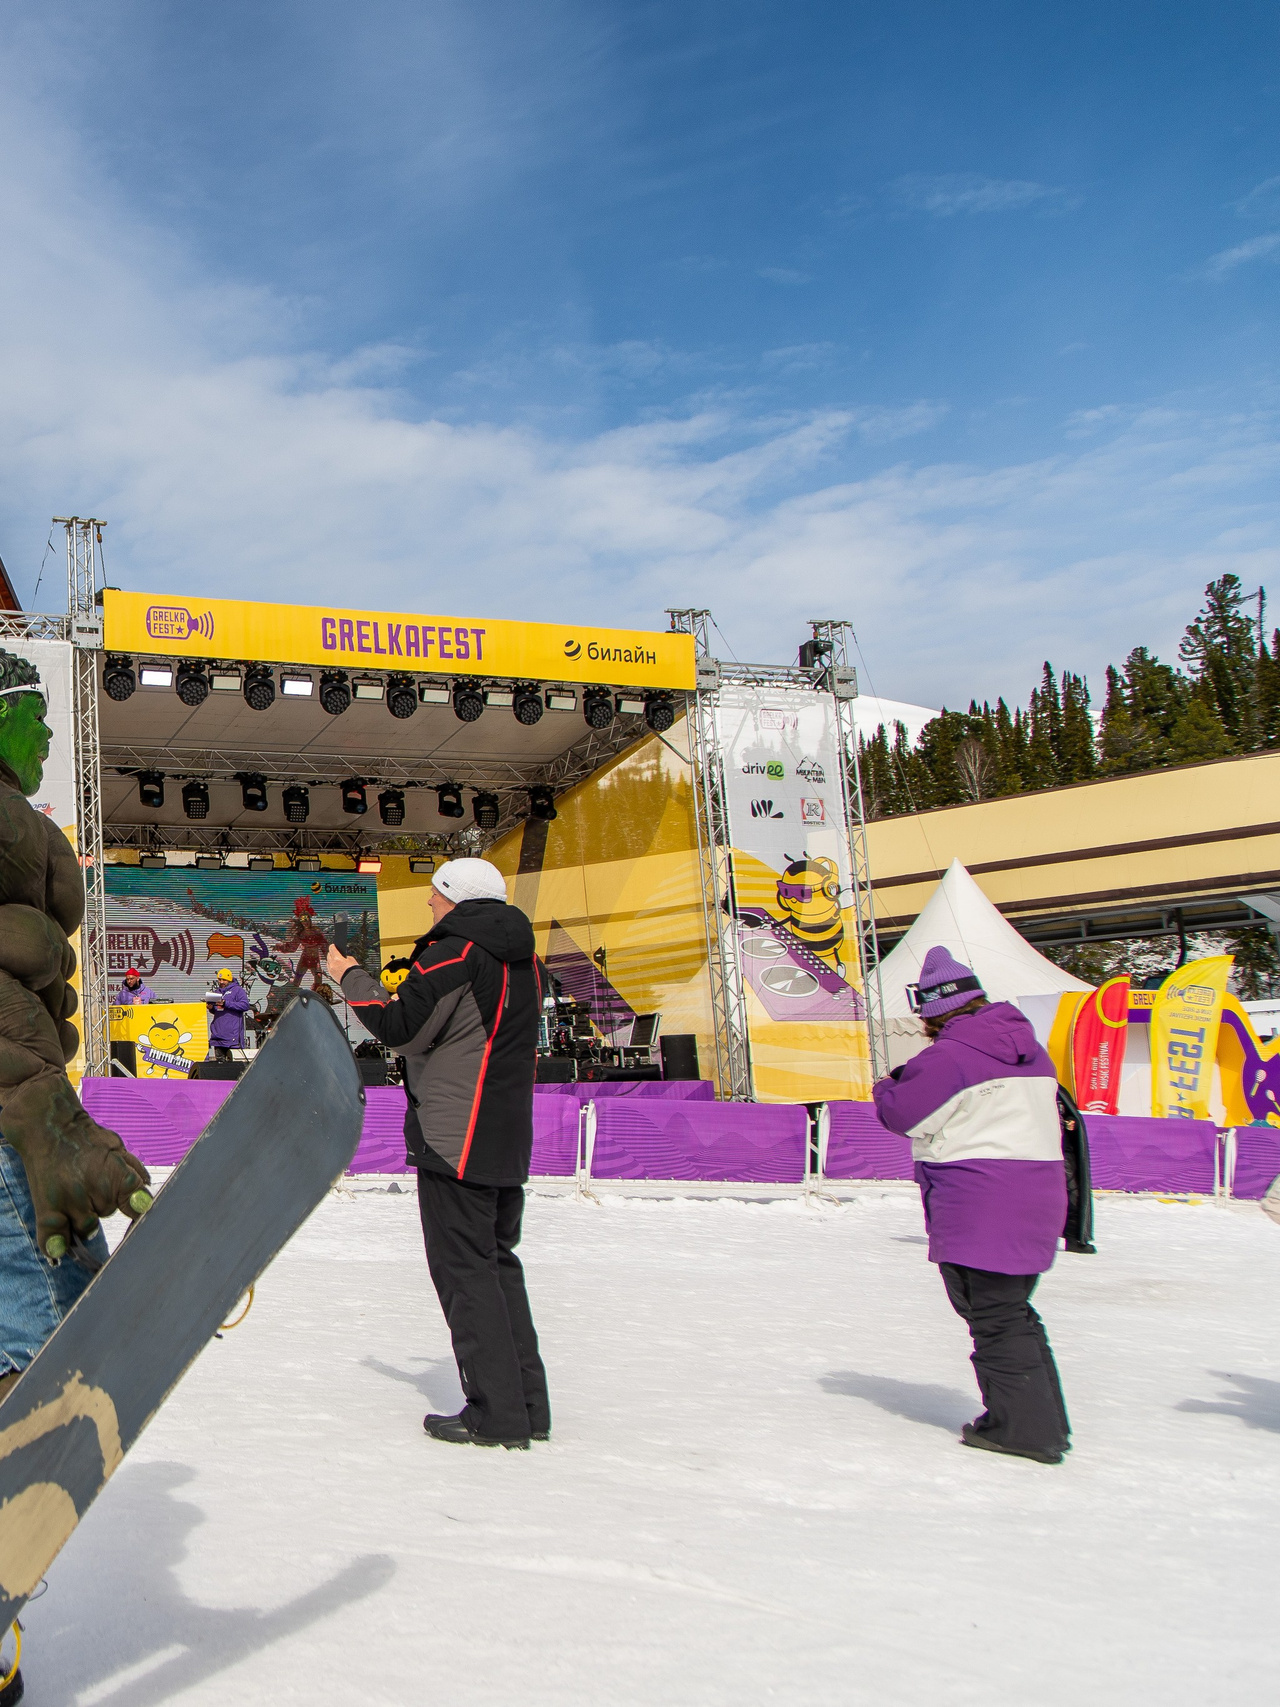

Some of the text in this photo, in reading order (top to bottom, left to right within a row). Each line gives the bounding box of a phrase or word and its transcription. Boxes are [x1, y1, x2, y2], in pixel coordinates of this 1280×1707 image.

[152, 610, 186, 623] GRELKA
[153, 623, 175, 634] FEST
[321, 617, 486, 660] GRELKAFEST
[587, 641, 657, 665] билайн
[742, 762, 784, 778] drivee
[324, 882, 367, 893] билайн
[100, 934, 150, 950] RELKA
[100, 953, 134, 969] EST
[1133, 992, 1156, 1006] GREL
[1099, 1041, 1109, 1090] MUSIC FESTIVAL
